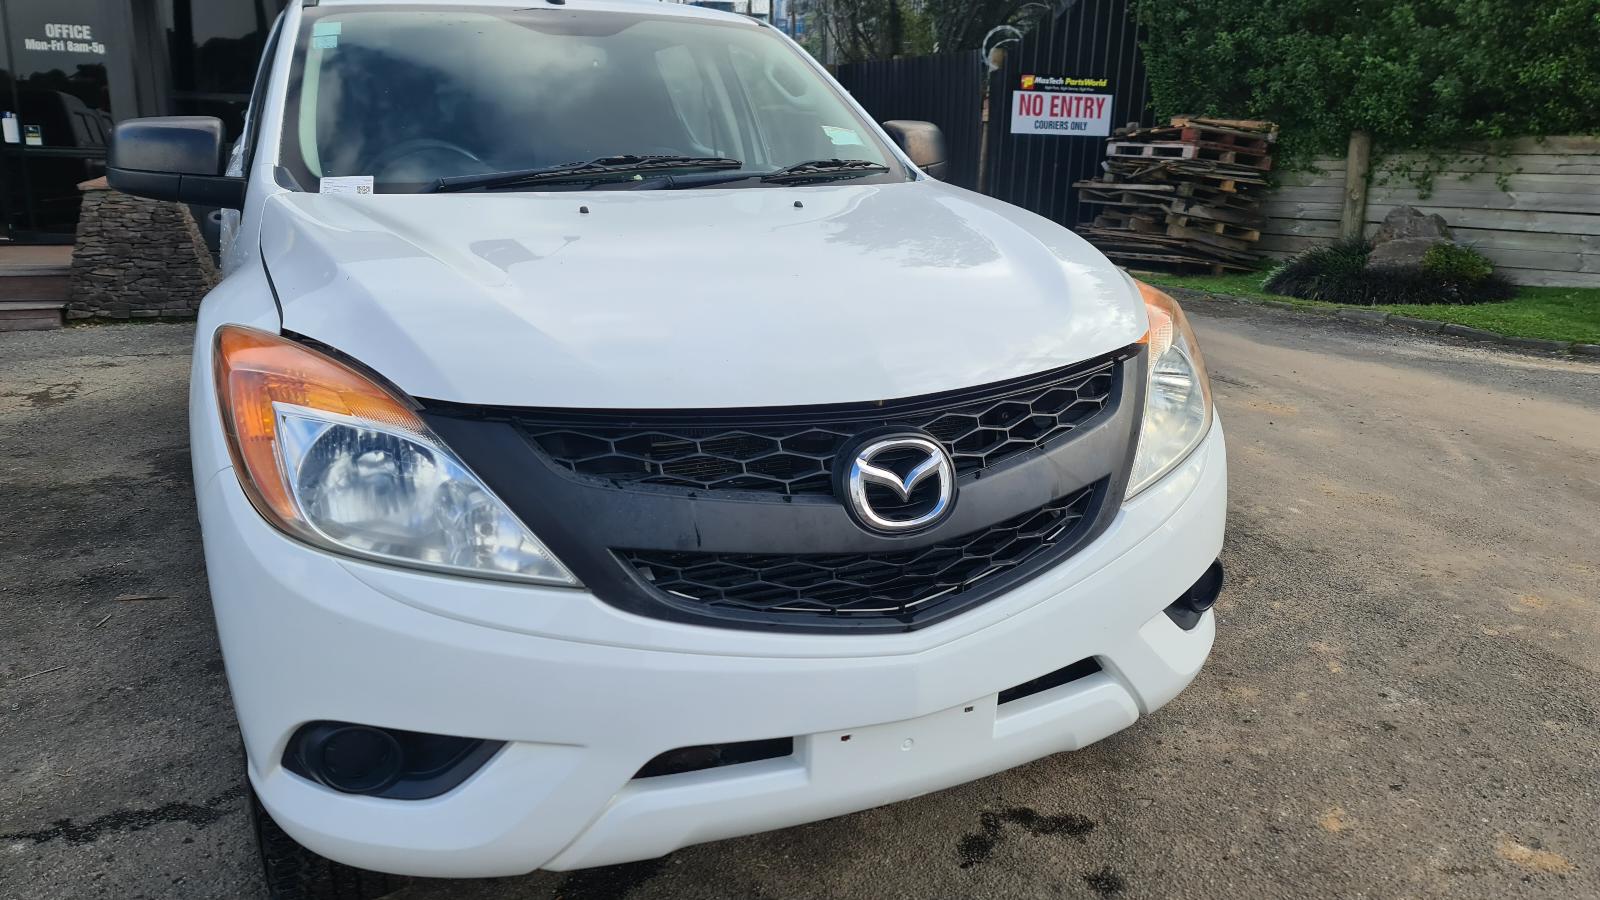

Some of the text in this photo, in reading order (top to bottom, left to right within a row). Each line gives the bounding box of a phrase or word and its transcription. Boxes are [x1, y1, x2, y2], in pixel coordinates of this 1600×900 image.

[45, 23, 92, 39] OFFICE
[24, 39, 65, 51] Mon-Fri
[1065, 77, 1108, 87] PartsWorld
[1018, 93, 1106, 119] NO ENTRY
[1034, 120, 1088, 131] COURIERS ONLY
